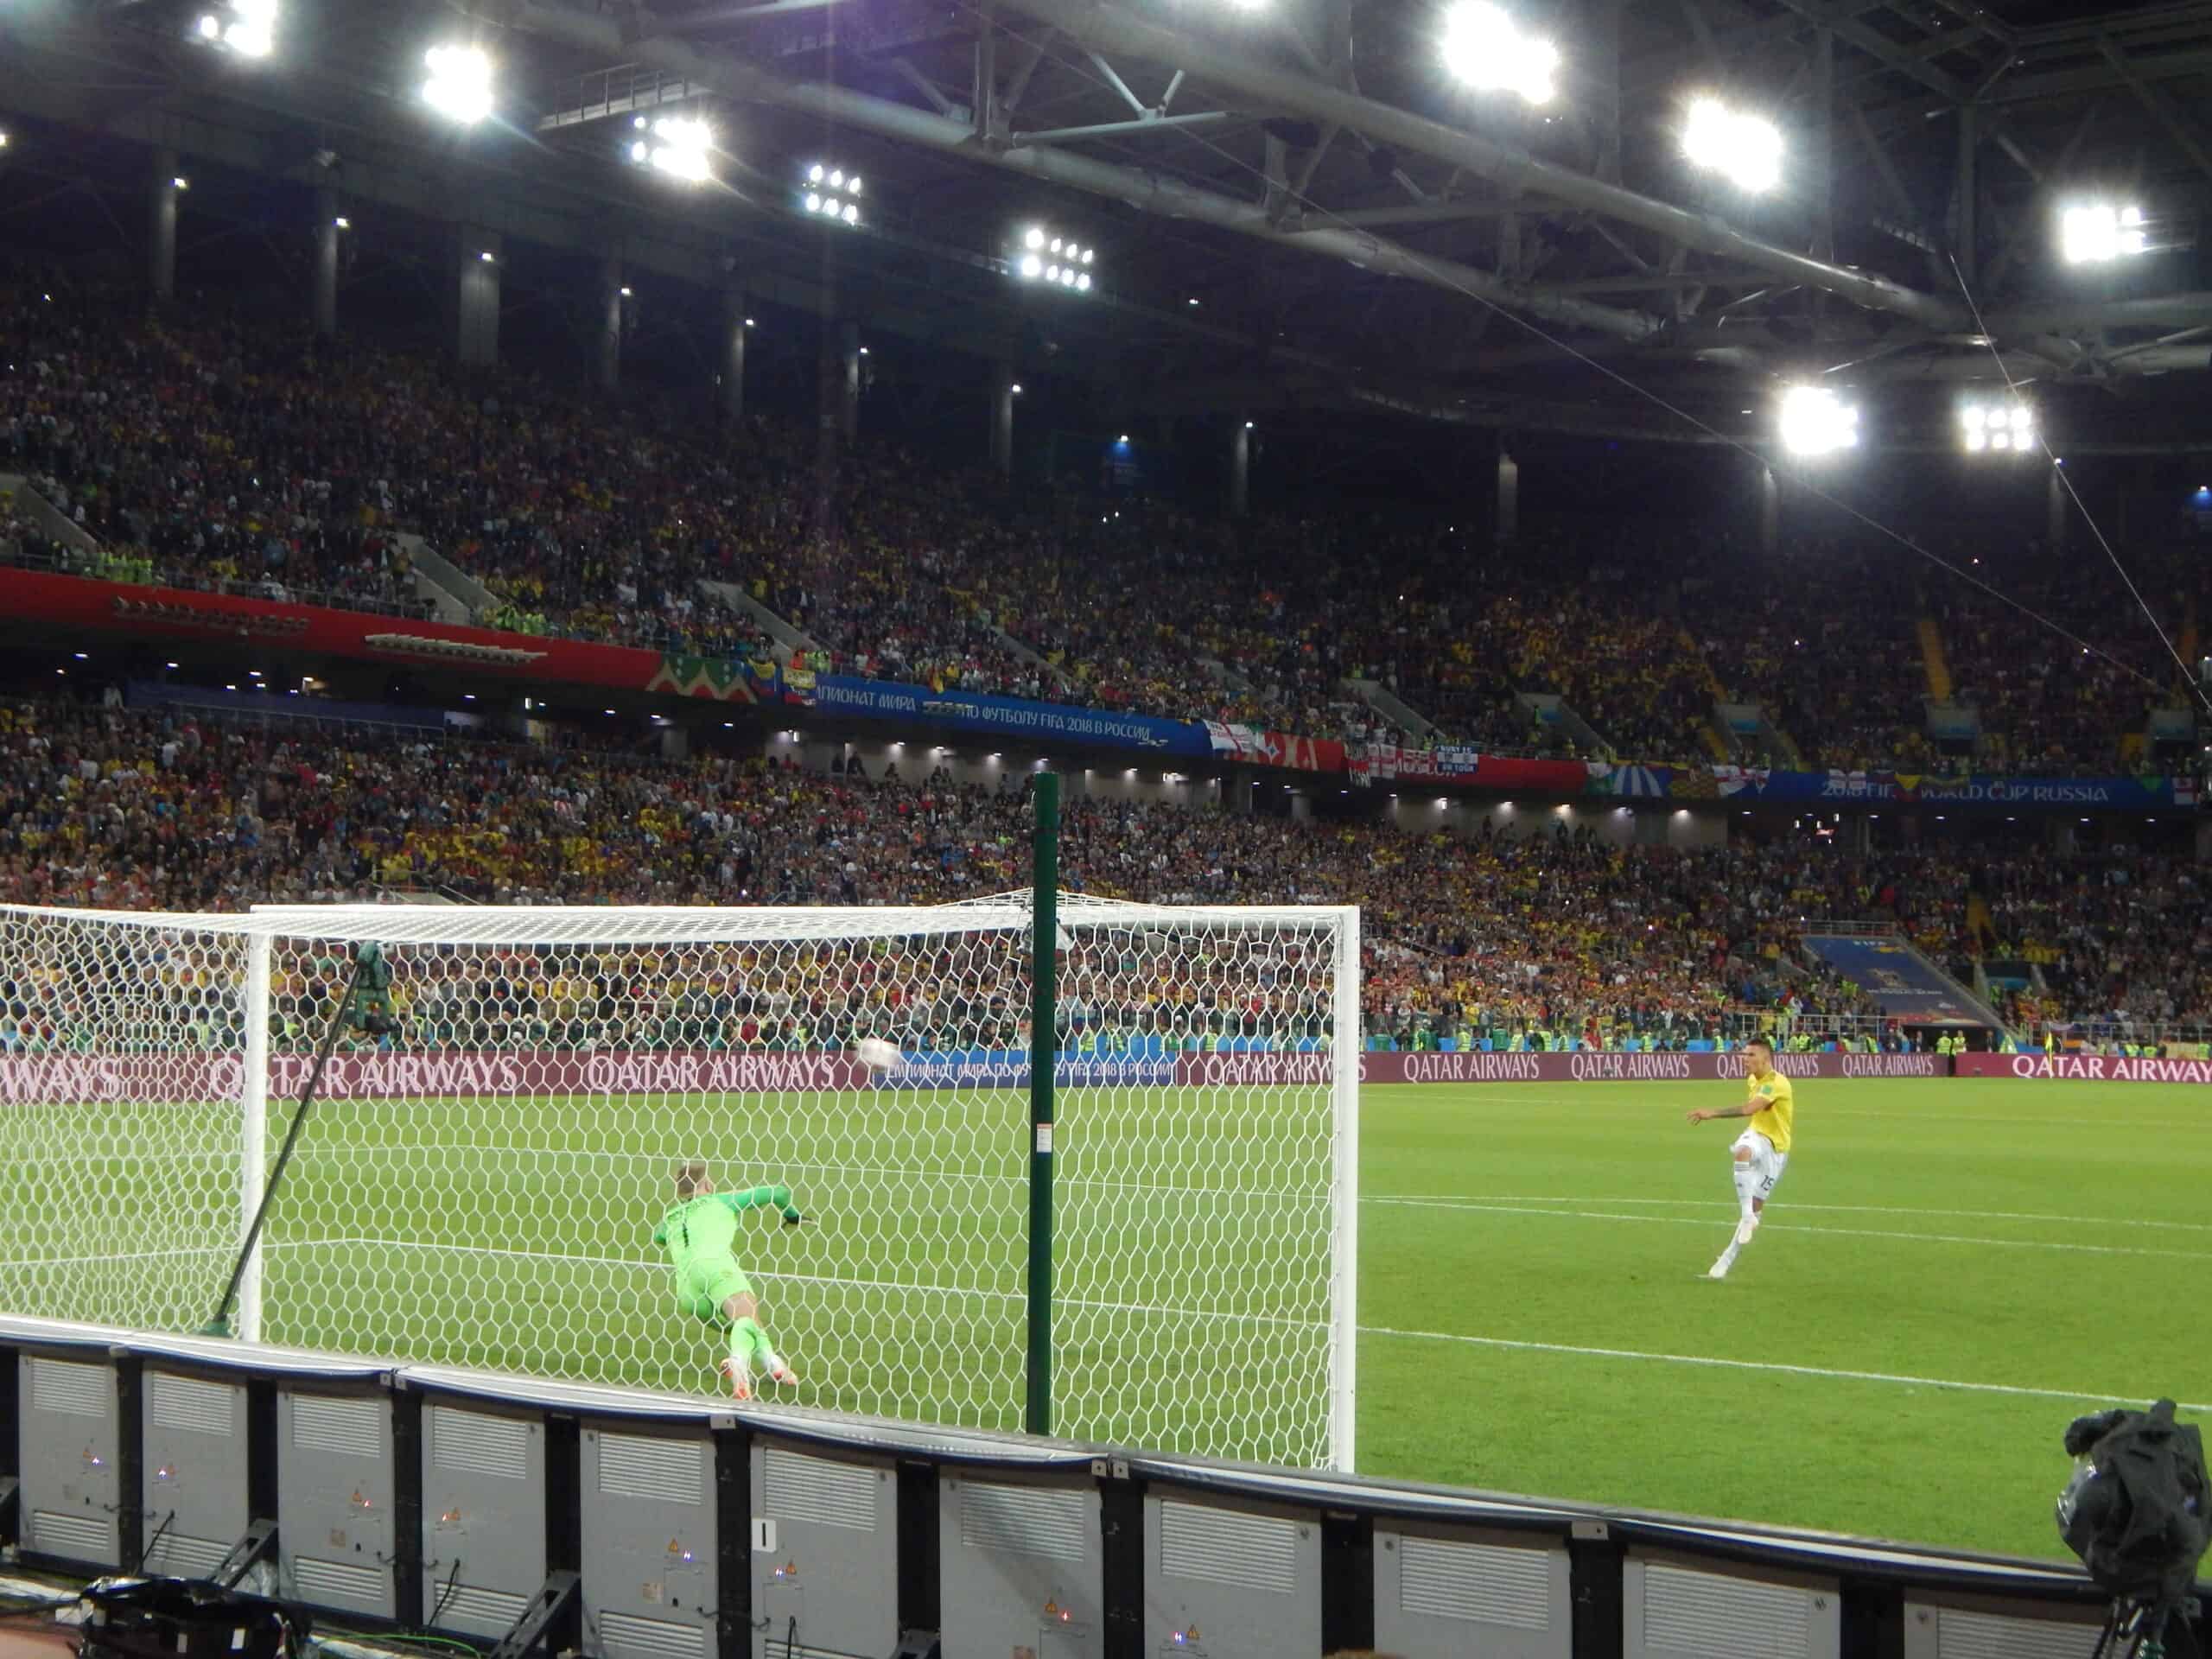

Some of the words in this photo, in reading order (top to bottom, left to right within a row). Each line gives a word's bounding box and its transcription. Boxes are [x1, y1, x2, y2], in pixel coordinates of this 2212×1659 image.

[816, 683, 875, 706] МПИОНАТ
[879, 692, 916, 712] МИРА
[982, 706, 1038, 726] ФУТБОЛУ
[1040, 712, 1065, 730] FIFA
[1067, 716, 1093, 734] 2018
[1105, 721, 1151, 741] РОССИИ
[2032, 786, 2109, 802] RUSSIA
[210, 1056, 348, 1100] QTAR
[359, 1056, 518, 1094] AIRWAYS
[588, 1055, 698, 1095] QATAR
[708, 1055, 836, 1089] AIRWAYS
[1093, 1063, 1117, 1077] 2018
[1206, 1054, 1278, 1084] QATAR
[1403, 1054, 1464, 1084] QATAR
[1468, 1054, 1540, 1079] AIRWAYS
[1571, 1054, 1624, 1081] QATAR
[1627, 1054, 1690, 1078] AIRWAYS
[1770, 1054, 1819, 1077] IRWAYS
[1842, 1055, 1882, 1078] QATAR
[1885, 1055, 1934, 1076] AIRWAYS
[2012, 1056, 2105, 1079] QATAR
